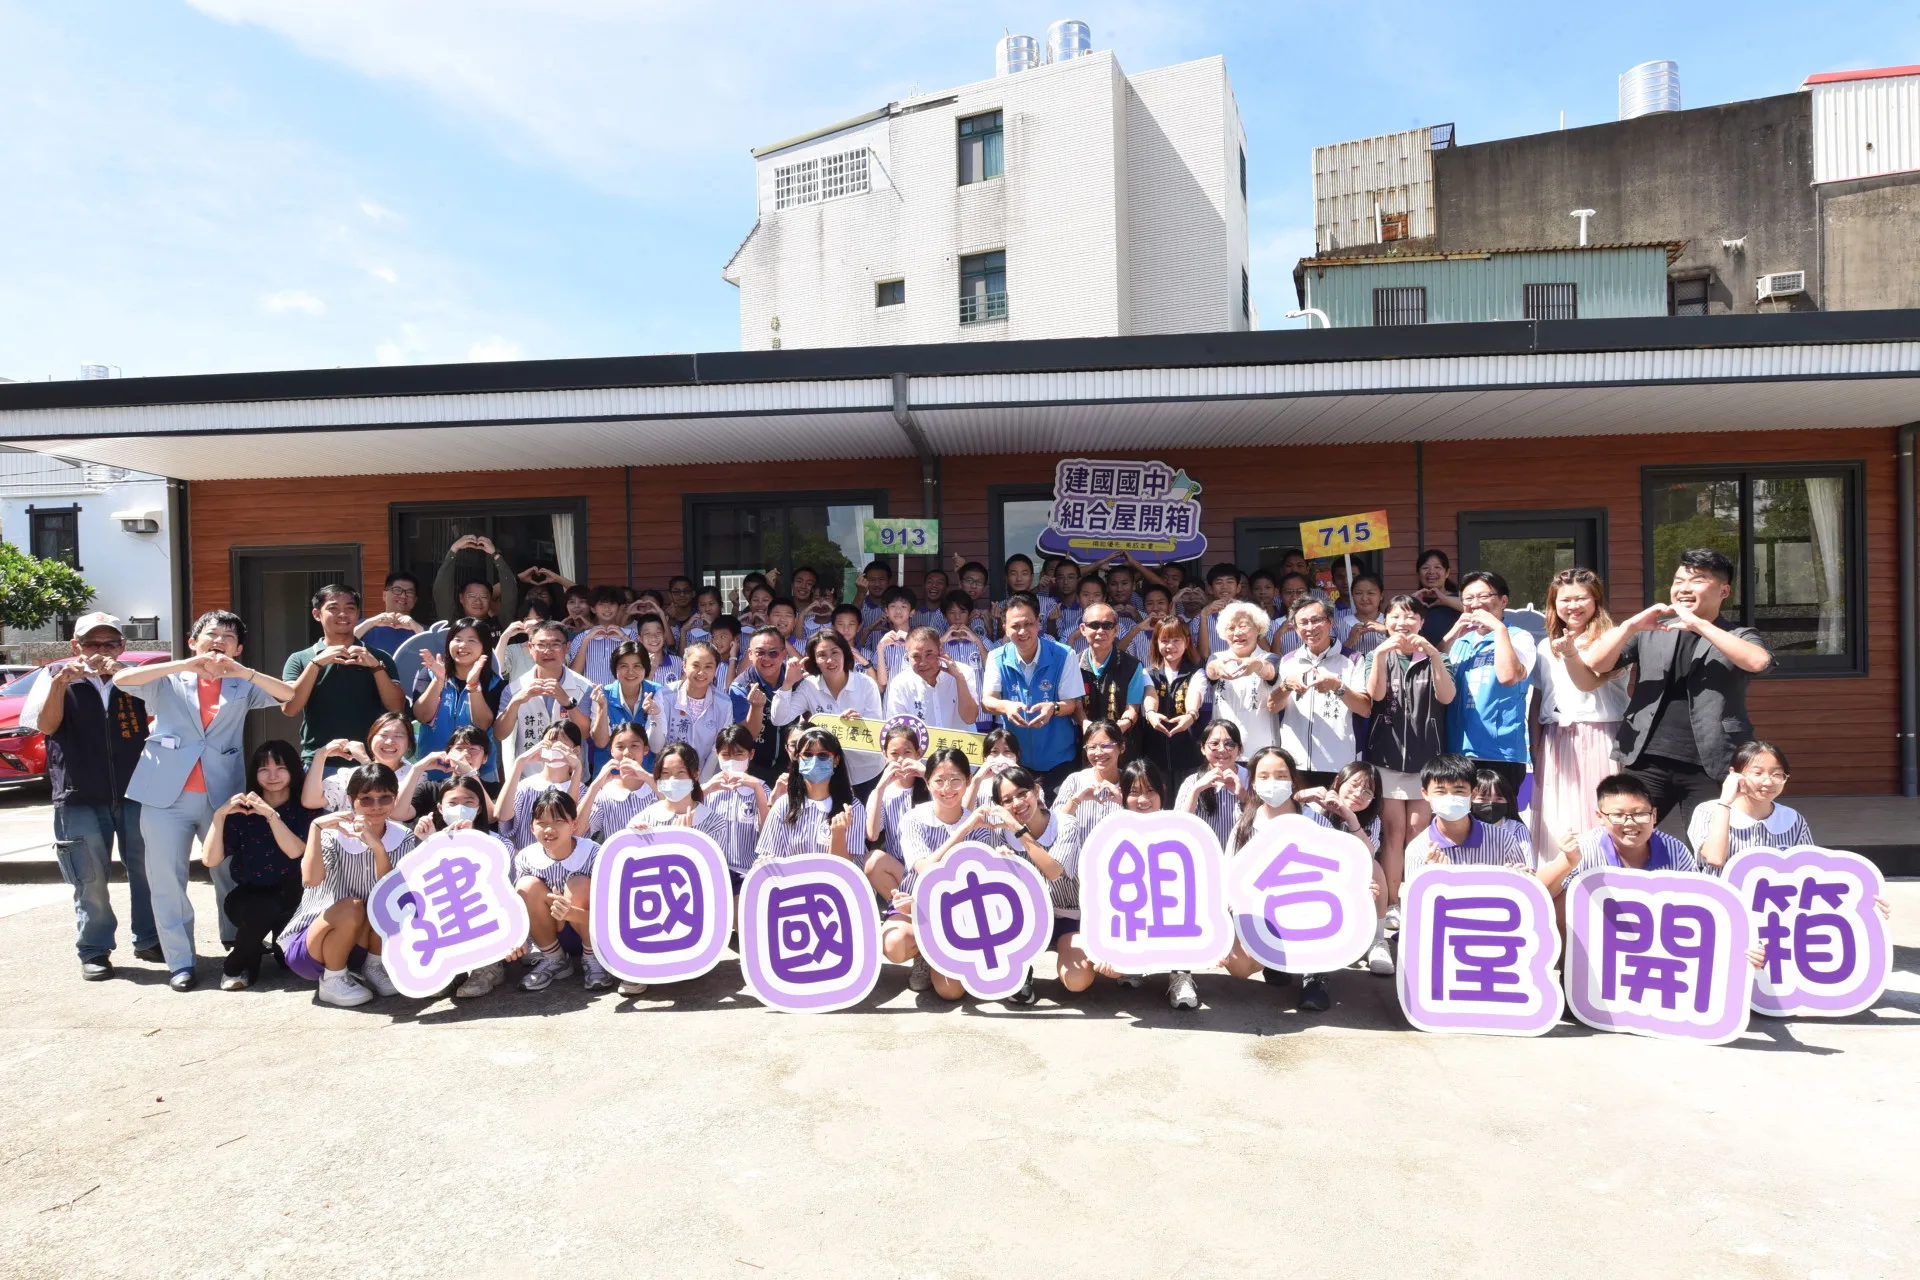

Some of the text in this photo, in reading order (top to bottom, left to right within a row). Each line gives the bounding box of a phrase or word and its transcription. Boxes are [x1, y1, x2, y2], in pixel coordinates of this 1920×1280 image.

[1060, 502, 1191, 534] 組合屋開箱
[1064, 466, 1166, 497] 建國國中
[881, 528, 925, 546] 913
[1319, 522, 1370, 546] 715
[414, 858, 499, 966] 建
[620, 854, 704, 953] 國
[768, 883, 853, 983] 國
[941, 872, 1024, 969] 中
[1108, 841, 1202, 941] 組
[1255, 845, 1342, 941] 合
[1753, 877, 1857, 985] 箱
[1432, 896, 1529, 1004] 屋
[1602, 899, 1716, 1013] 開
